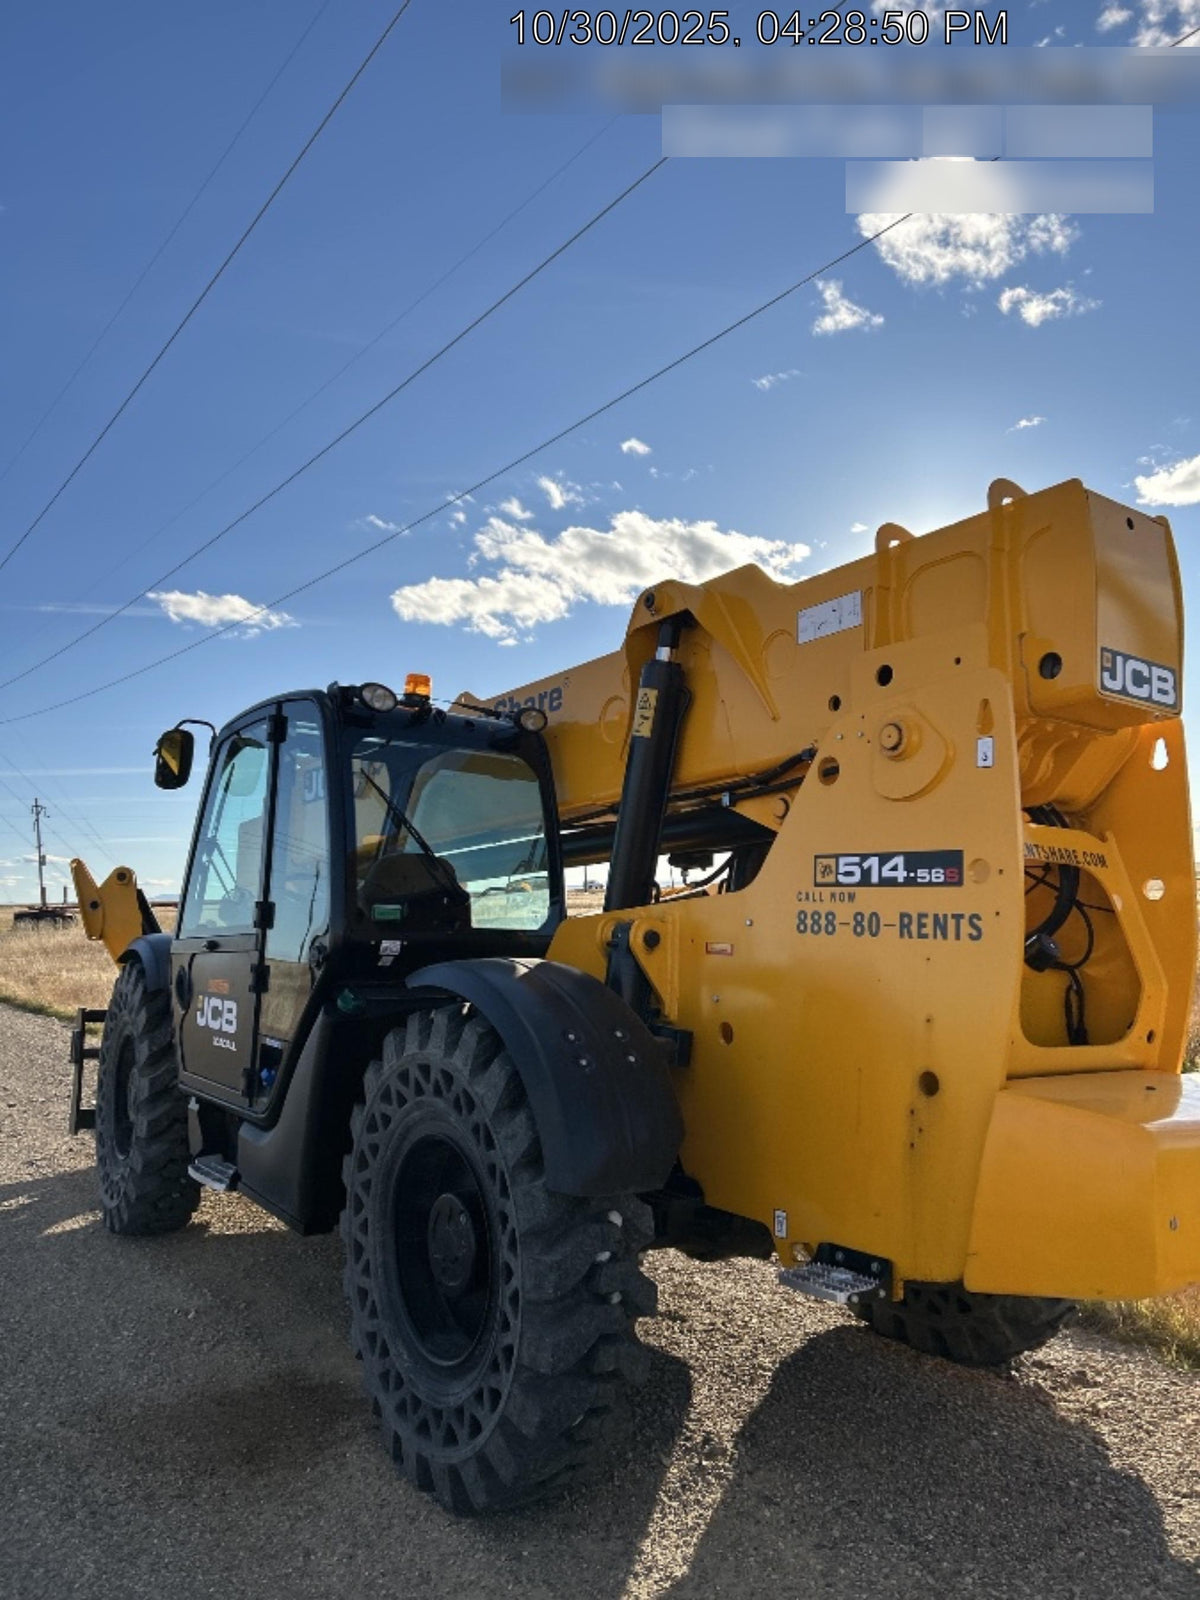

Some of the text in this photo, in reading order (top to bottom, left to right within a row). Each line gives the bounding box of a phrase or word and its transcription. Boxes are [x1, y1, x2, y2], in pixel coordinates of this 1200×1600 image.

[1102, 655, 1176, 705] JCB
[796, 891, 857, 903] CALL NOW
[796, 909, 983, 942] 888-80-RENTS
[196, 995, 238, 1034] JCB
